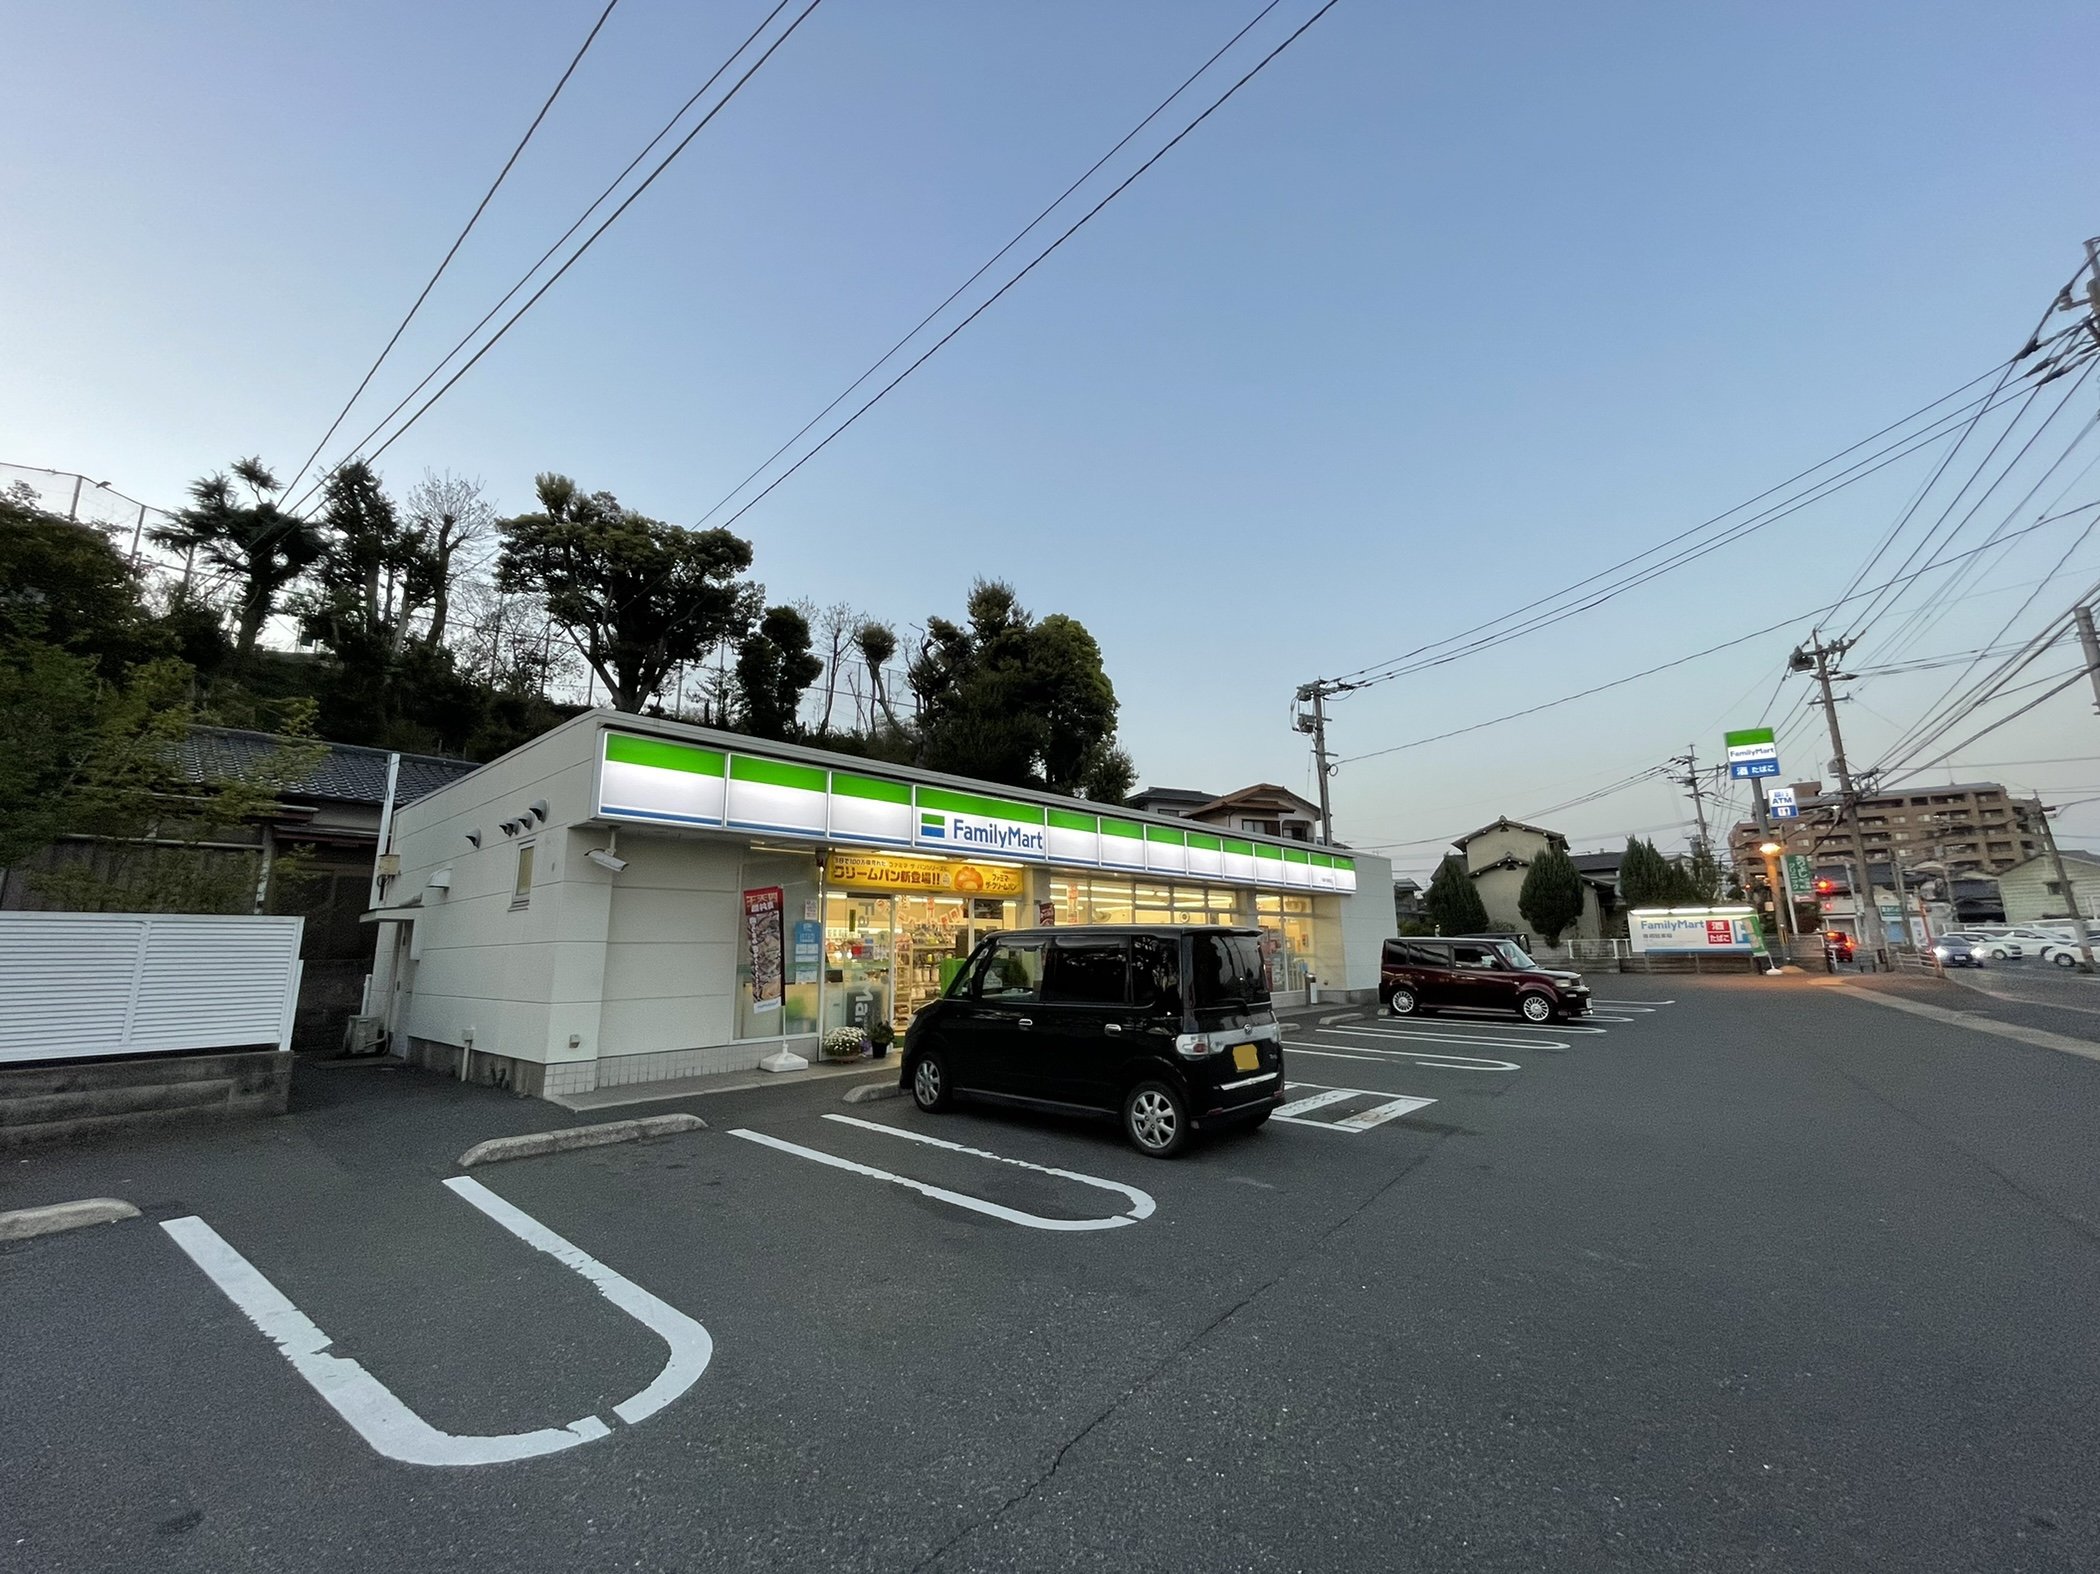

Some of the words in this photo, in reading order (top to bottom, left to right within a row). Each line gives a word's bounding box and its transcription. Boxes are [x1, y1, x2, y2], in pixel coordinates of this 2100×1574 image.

[1730, 746, 1775, 757] FamilyMart
[1736, 766, 1749, 776] 酒
[1751, 765, 1775, 774] たばこ
[1772, 797, 1792, 805] ATM
[953, 818, 1043, 849] FamilyMart
[1641, 919, 1704, 931] FamilyMart
[1711, 921, 1725, 931] 酒
[1709, 934, 1731, 943] たばこ
